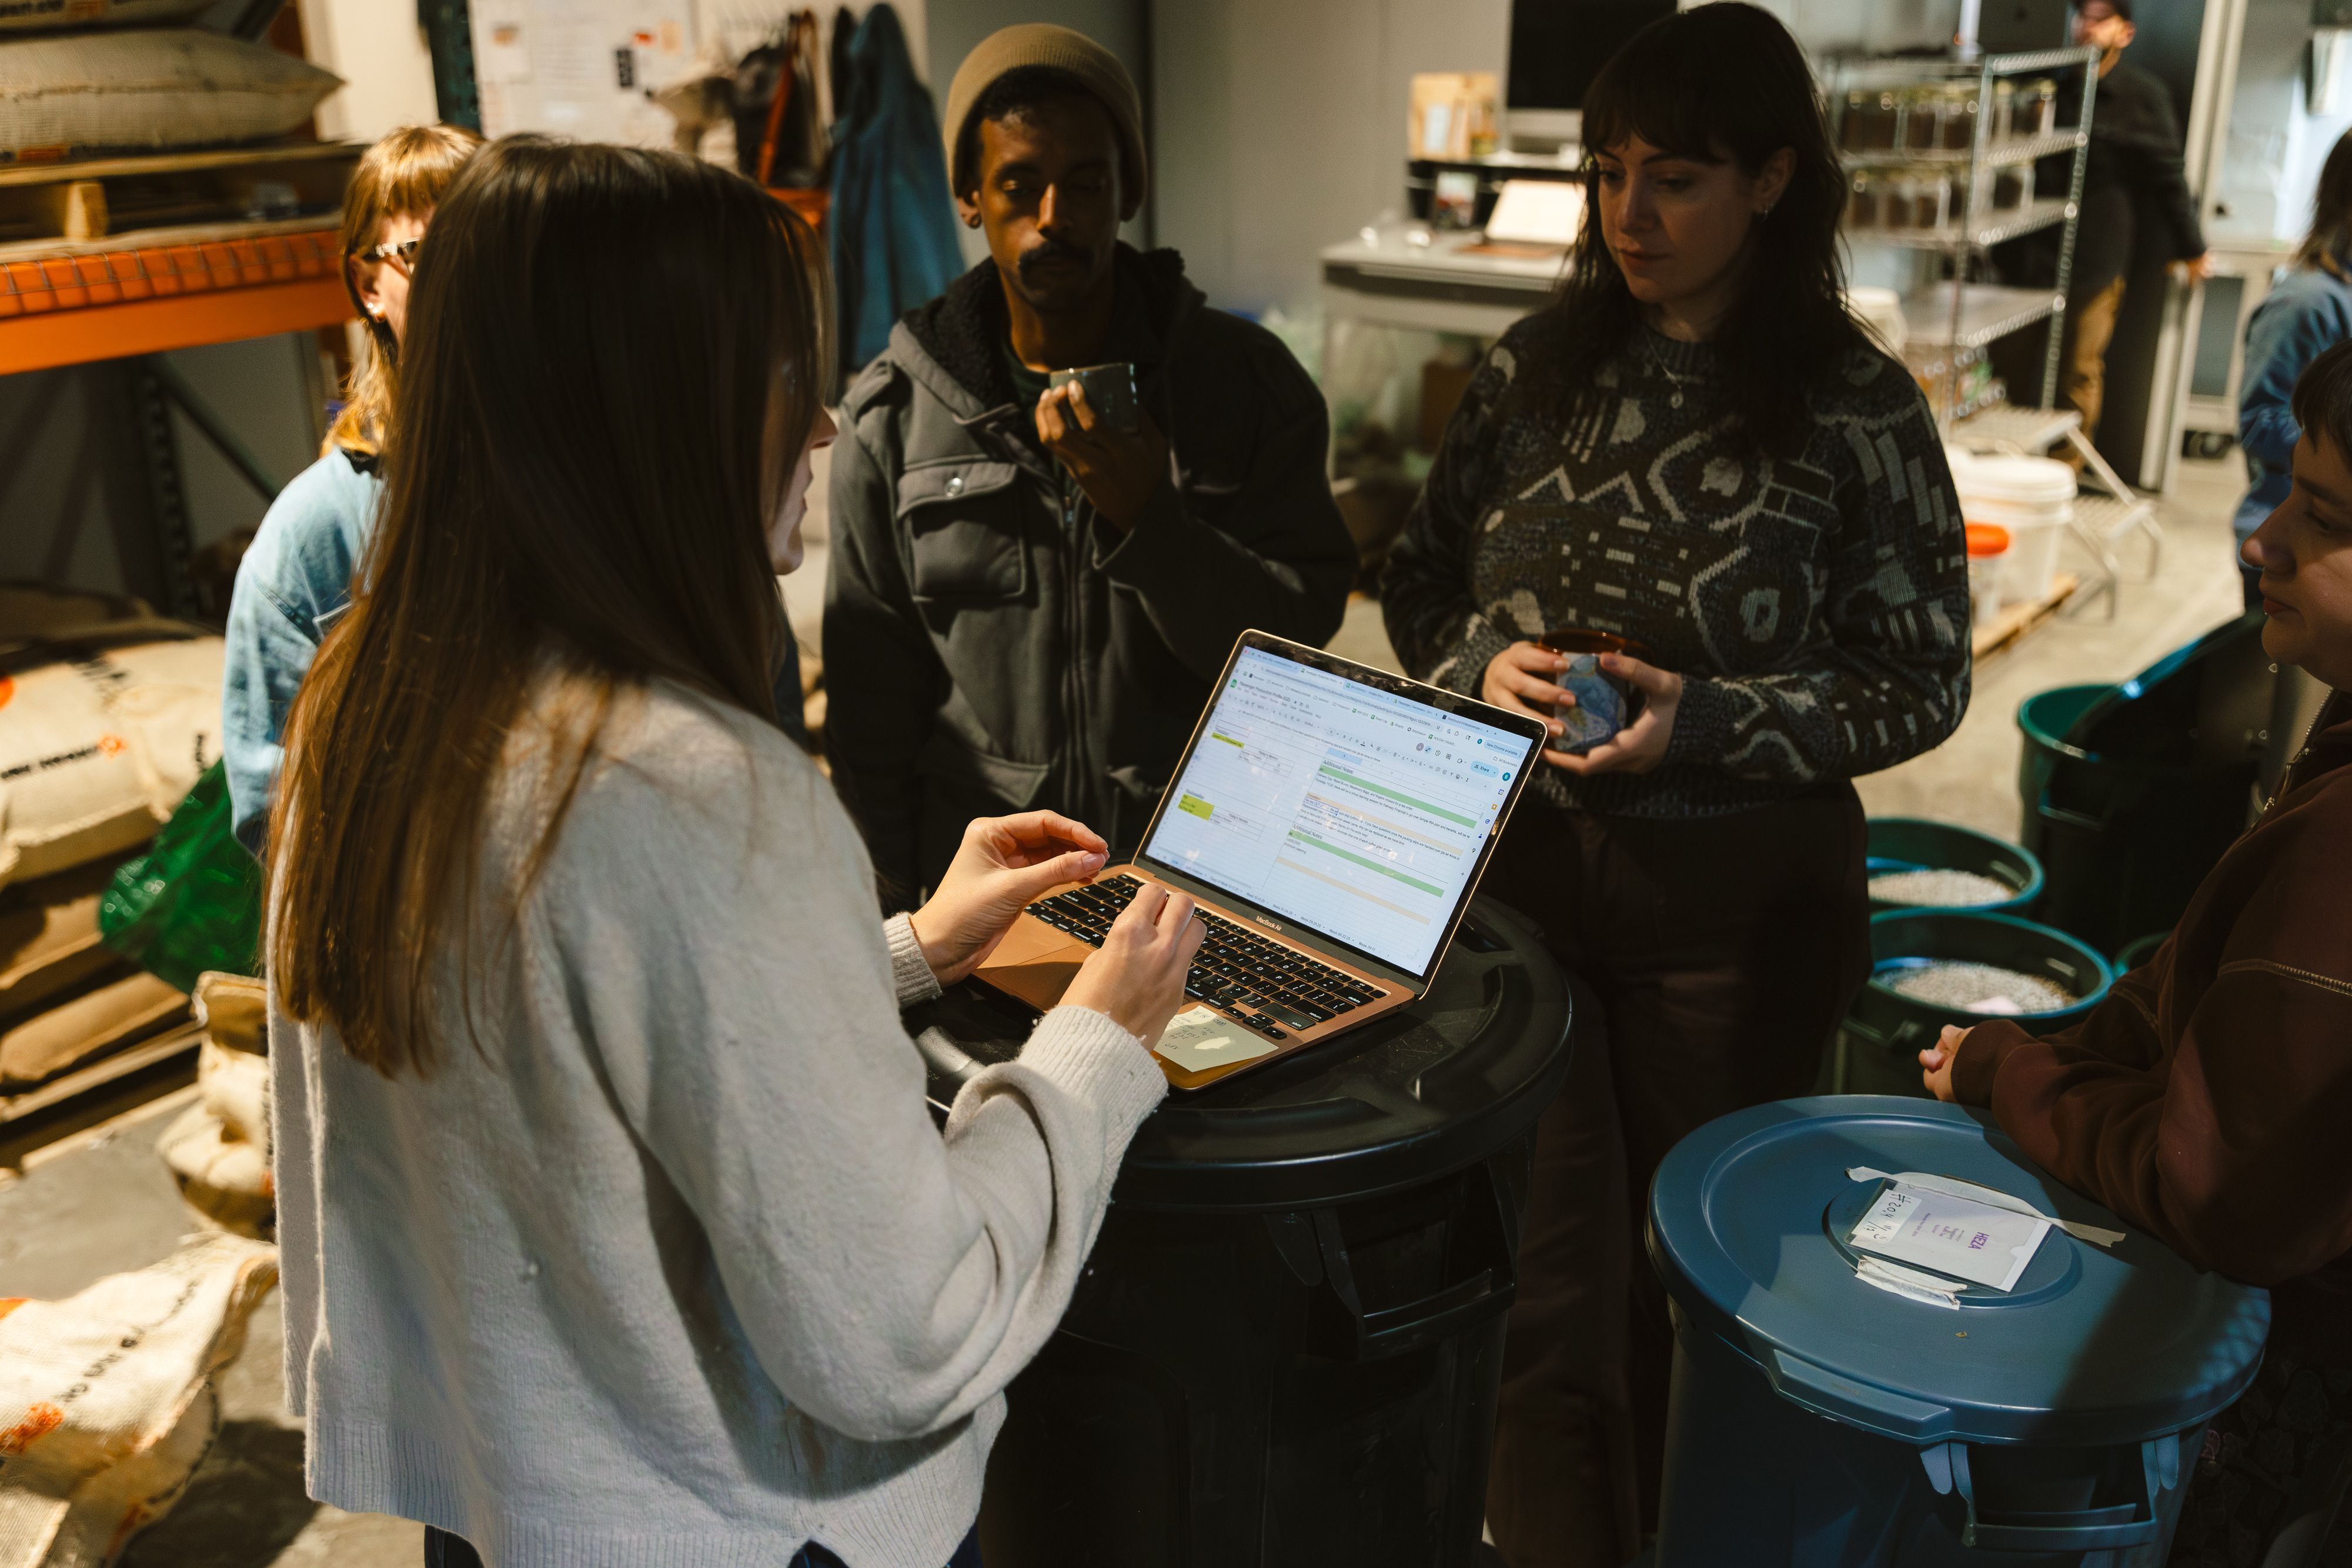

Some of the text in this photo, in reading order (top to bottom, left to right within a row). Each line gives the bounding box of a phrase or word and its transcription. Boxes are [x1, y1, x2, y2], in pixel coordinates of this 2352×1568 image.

[1322, 759, 1342, 770] Additional
[1292, 823, 1312, 835] Additional
[1378, 826, 1391, 834] questions
[1256, 915, 1276, 930] MacBook
[1185, 987, 1204, 997] command
[1967, 1232, 1990, 1249] HEZA
